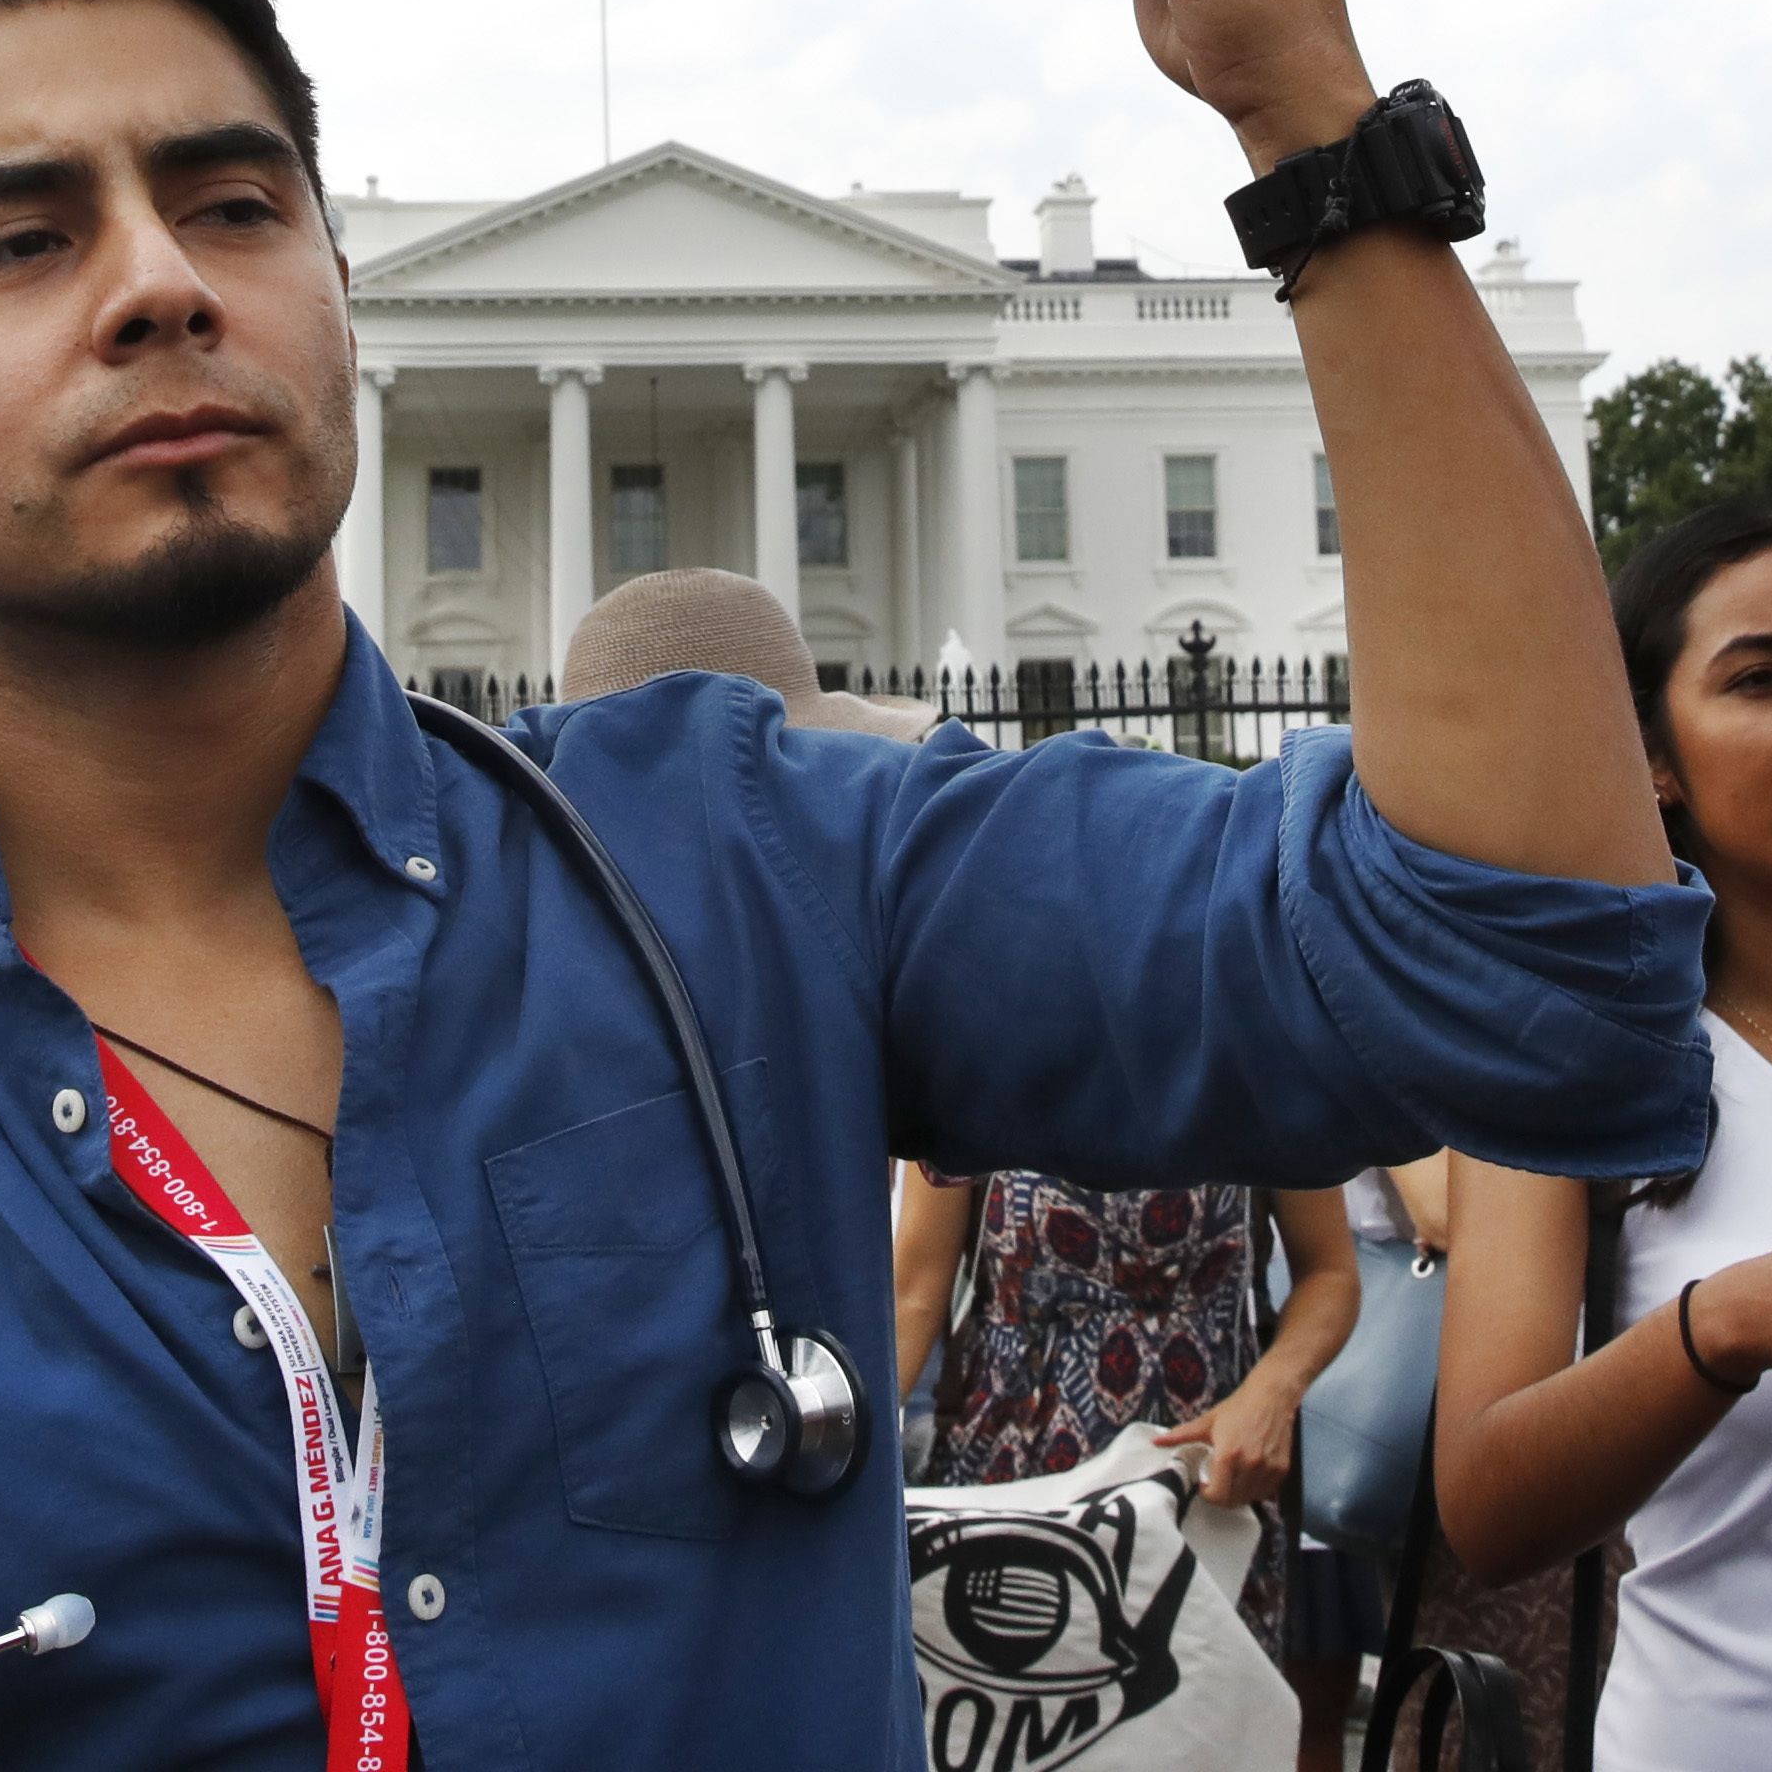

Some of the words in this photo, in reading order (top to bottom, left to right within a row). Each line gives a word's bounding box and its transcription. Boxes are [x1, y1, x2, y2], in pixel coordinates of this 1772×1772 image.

[236, 1268, 280, 1328] UNIVERSITARIO
[259, 1283, 284, 1314] SYSTEM
[277, 1329, 297, 1368] SISTEMA
[280, 1314, 306, 1367] UNIVERSITY
[316, 1372, 332, 1420] Language
[295, 1374, 331, 1494] MÉNDEZ
[327, 1420, 337, 1441] Dual
[368, 1466, 379, 1492] UMET
[312, 1493, 335, 1523] G.
[315, 1524, 344, 1588] ANA
